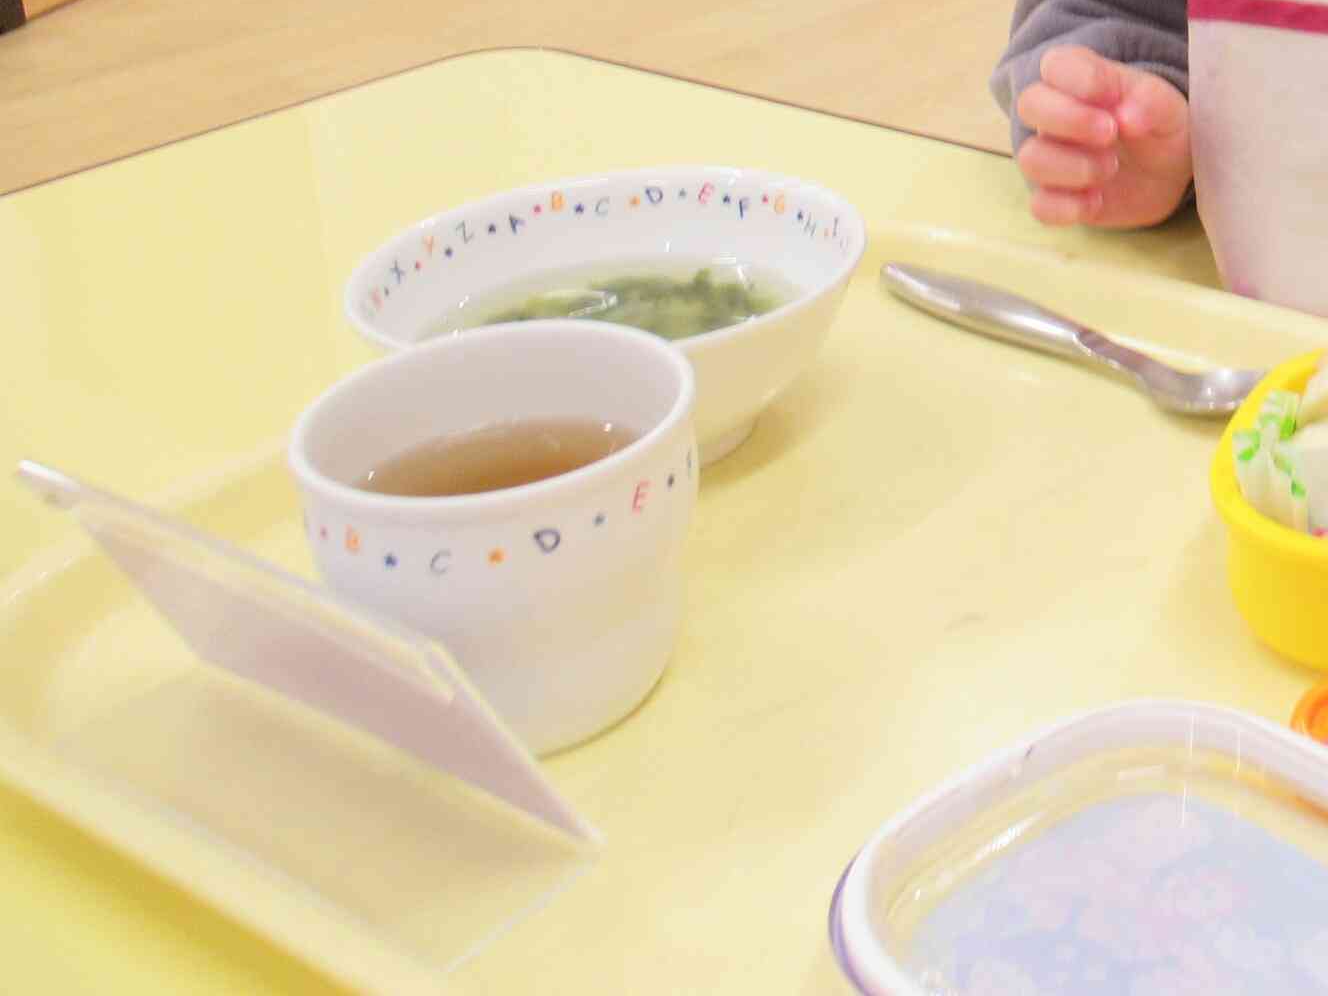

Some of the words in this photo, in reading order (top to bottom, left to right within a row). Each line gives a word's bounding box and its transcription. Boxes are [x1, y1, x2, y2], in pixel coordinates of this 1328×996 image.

[455, 220, 475, 244] Z
[508, 212, 527, 235] A
[594, 196, 613, 218] C
[645, 186, 664, 206] D
[738, 197, 751, 219] F
[428, 549, 454, 576] C
[532, 527, 562, 553] D
